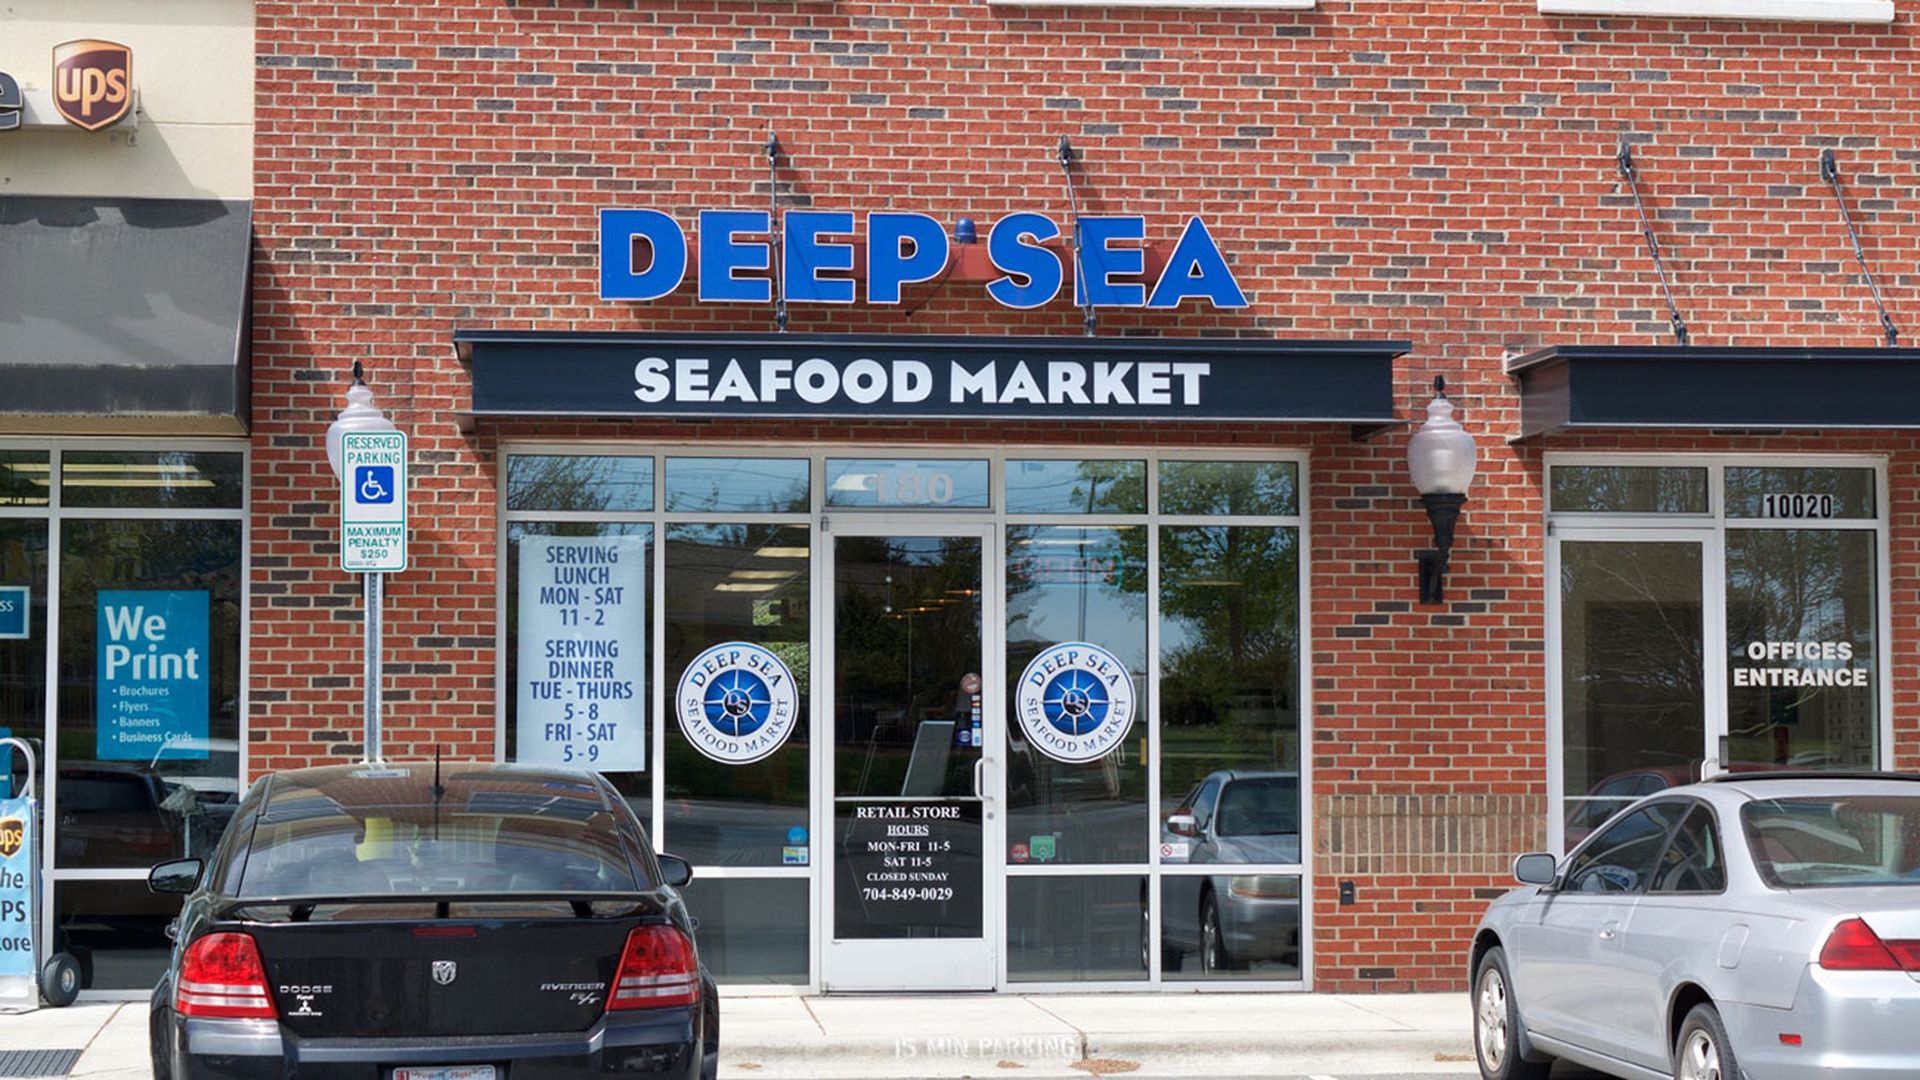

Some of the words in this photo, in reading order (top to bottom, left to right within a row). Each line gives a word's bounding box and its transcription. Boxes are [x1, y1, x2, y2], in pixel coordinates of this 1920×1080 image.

[58, 67, 127, 117] ups
[599, 208, 950, 305] DEEP
[985, 211, 1250, 310] SEA
[633, 356, 934, 405] SEAFOOD
[949, 359, 1212, 406] MARKET
[346, 436, 401, 450] RESERVED
[347, 452, 400, 464] PARKING
[863, 470, 954, 504] 180
[1765, 495, 1833, 519] 10020
[346, 527, 401, 537] MAXIMUM
[348, 538, 400, 548] PENALTY
[360, 549, 389, 559] $250
[546, 545, 619, 564] SERVING
[554, 566, 610, 585] LUNCH
[539, 587, 580, 605] MON
[594, 586, 624, 605] SAT
[104, 605, 167, 641] We
[560, 608, 578, 626] 11
[594, 608, 605, 626] 2
[545, 639, 619, 658] SERVING
[1748, 641, 1853, 661] OFFICES
[105, 643, 199, 681] Print
[549, 661, 614, 679] DINNER
[690, 650, 740, 688] DEEP
[747, 653, 782, 687] SEA
[1029, 650, 1078, 688] DEEP
[1086, 653, 1120, 687] SEA
[1733, 668, 1868, 687] ENTRANCE
[119, 685, 170, 697] Brochures
[530, 681, 562, 700] TUE
[577, 681, 634, 700] THURS
[119, 701, 150, 713] Flyers
[564, 703, 573, 721] 5
[588, 703, 599, 721] 8
[119, 717, 161, 728] Banners
[687, 697, 739, 754] SEAFOOD
[744, 697, 788, 753] MARKET
[1027, 697, 1078, 753] SEAFOOD
[1083, 697, 1126, 752] MARKET
[119, 732, 163, 743] Business
[164, 731, 193, 743] Cards
[545, 723, 572, 742] FRI
[587, 723, 617, 742] SAT
[563, 744, 573, 763] 5
[588, 744, 599, 763] 9
[857, 806, 911, 819] RETAIL
[912, 806, 961, 819] STORE
[887, 824, 930, 836] HOURS
[867, 841, 920, 852] MON-FRI
[883, 856, 907, 867] SAT
[911, 856, 932, 867] 11-5
[0, 866, 25, 889] he
[866, 872, 908, 882] CLOSED
[908, 872, 949, 882] SUNDAY
[862, 887, 953, 901] 704-849-0029
[1, 899, 26, 923] PS
[280, 985, 333, 994] DODGE
[541, 982, 606, 991] AVENGER
[895, 1037, 916, 1058] 15
[927, 1037, 969, 1058] MIN
[978, 1037, 1076, 1058] PARKING
